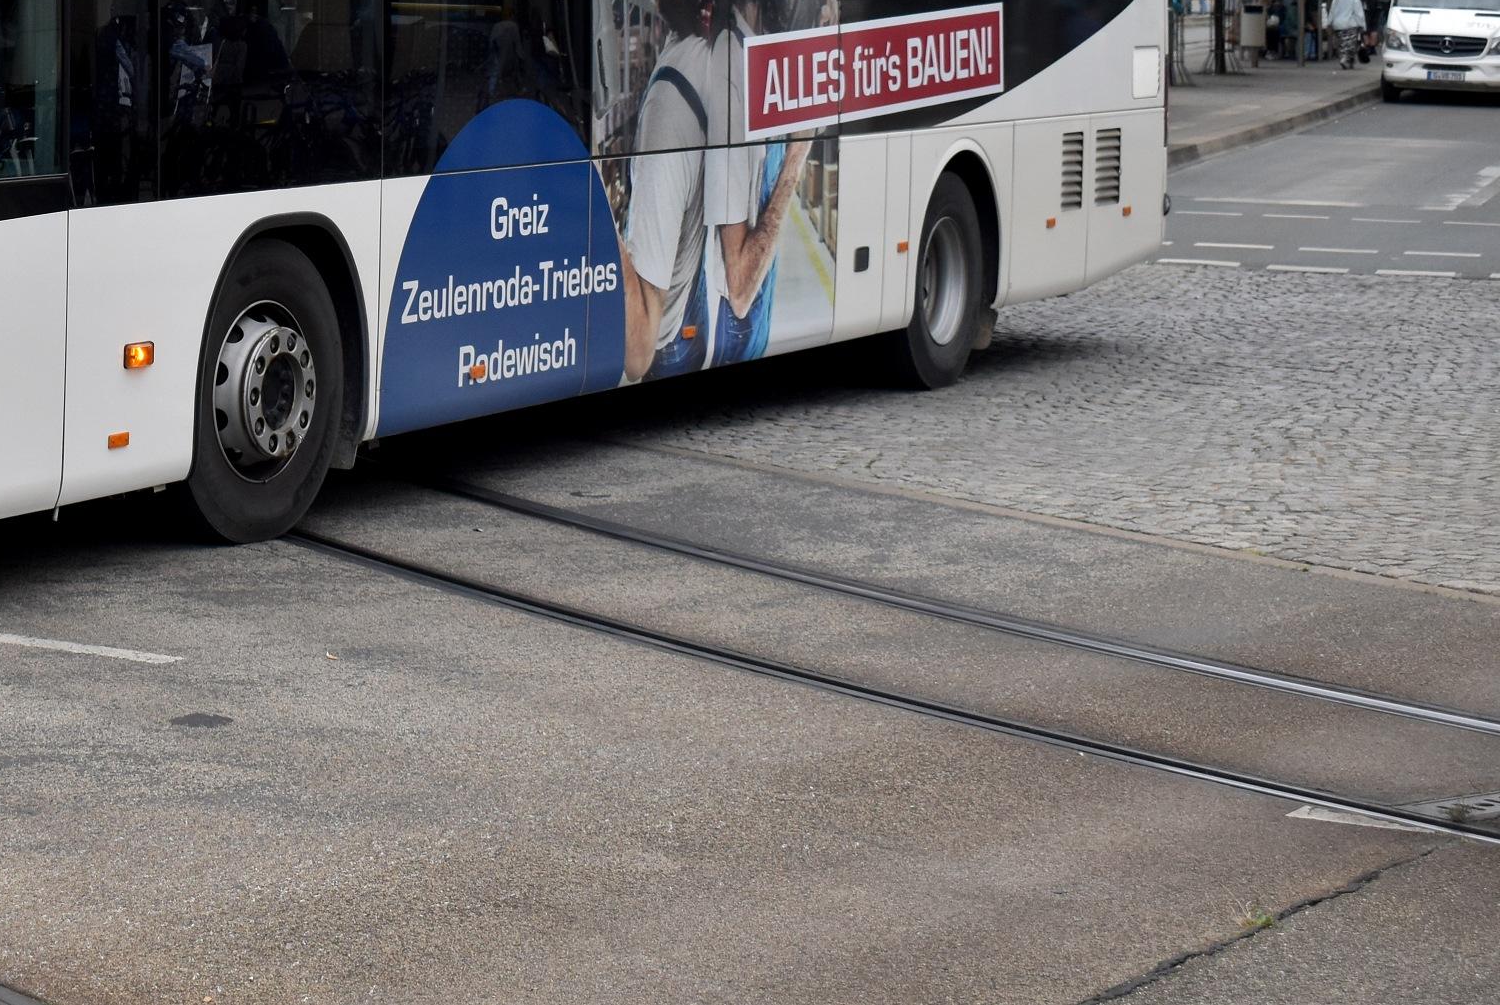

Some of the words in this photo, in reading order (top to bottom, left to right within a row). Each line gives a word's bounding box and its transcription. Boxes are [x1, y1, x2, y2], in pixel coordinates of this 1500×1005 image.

[763, 48, 845, 114] ALLES
[852, 41, 900, 97] für's
[907, 26, 993, 89] BAUEN!
[490, 193, 548, 240] Greiz
[402, 254, 617, 325] Zeulenroda-Triebes
[457, 328, 576, 387] Rodewisch
